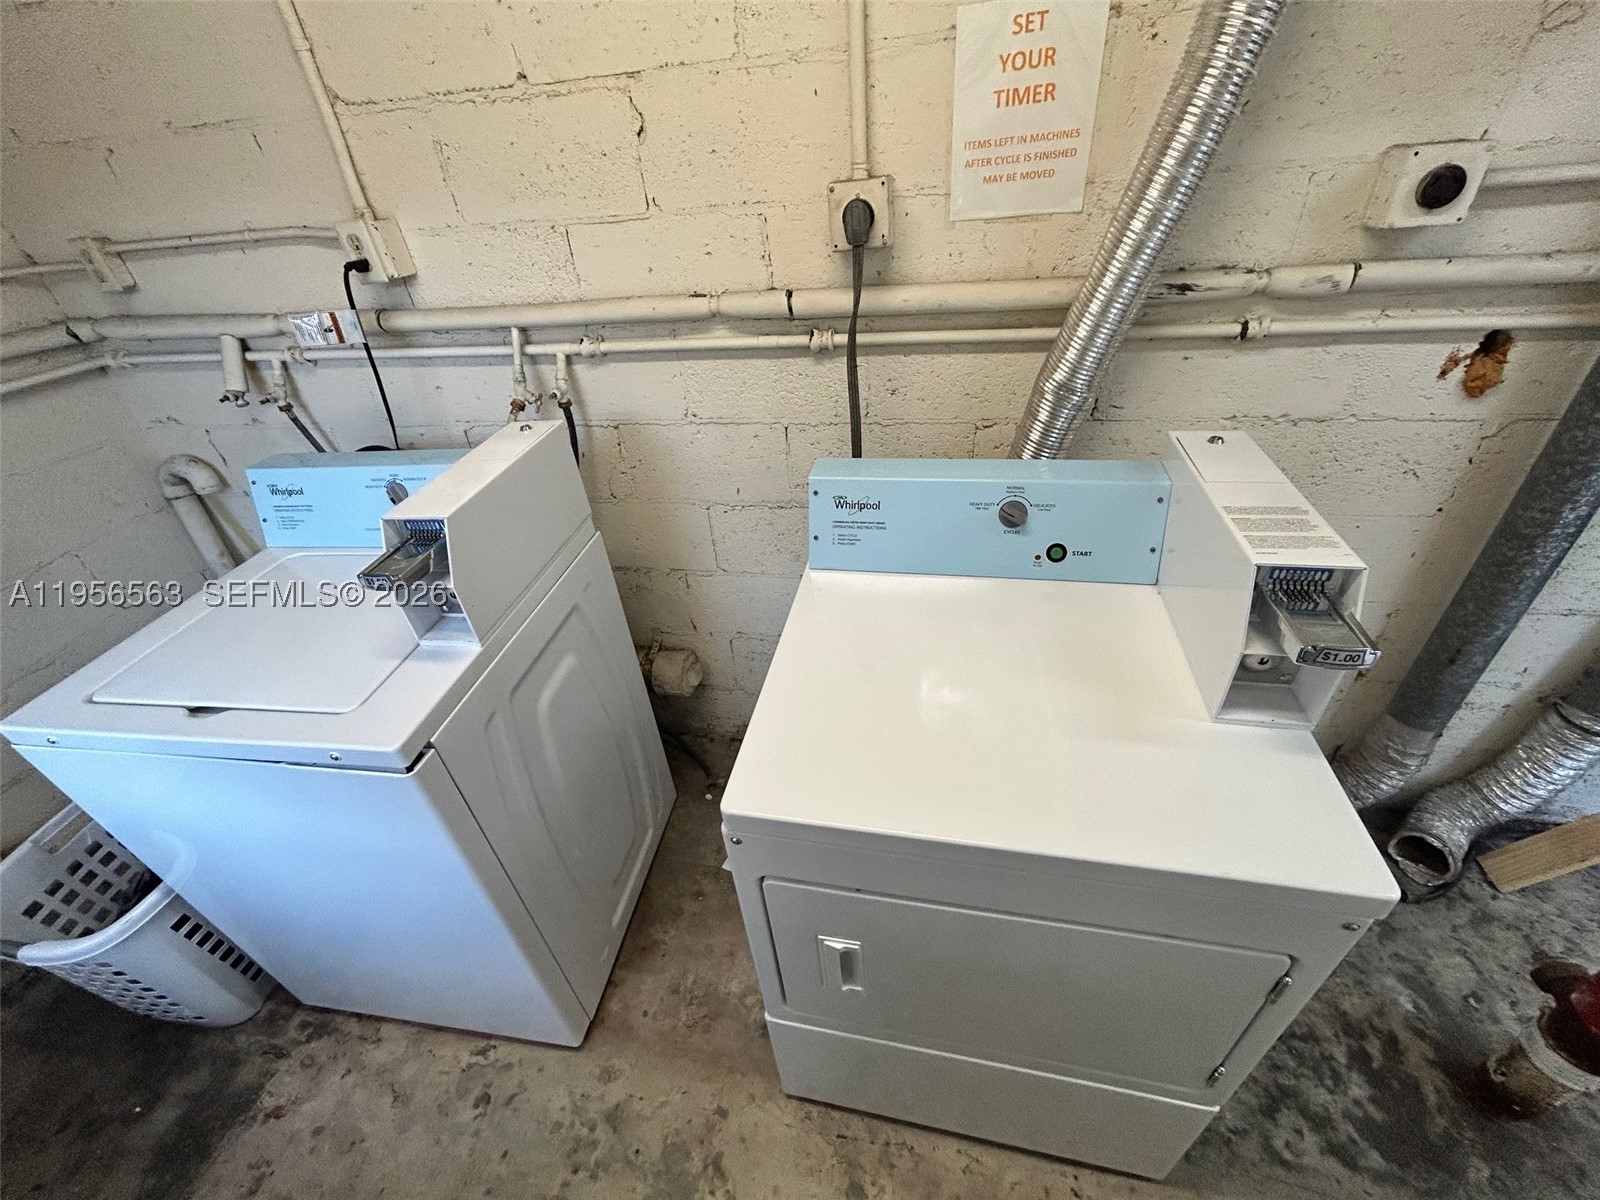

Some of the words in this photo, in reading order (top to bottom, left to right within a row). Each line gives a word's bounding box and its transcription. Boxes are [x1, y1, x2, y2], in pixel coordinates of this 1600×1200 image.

[1012, 9, 1050, 36] SET
[998, 46, 1057, 73] YOUR
[993, 82, 1057, 109] TIMER
[964, 139, 992, 150] ITEMS
[994, 136, 1015, 148] LEFT
[1017, 135, 1028, 145] IN
[1030, 128, 1081, 144] MACHINES
[964, 157, 992, 169] AFTER
[994, 154, 1021, 166] CYCLE
[1023, 152, 1032, 163] IS
[1034, 148, 1078, 161] FINISHED
[983, 174, 1004, 185] MAY
[1006, 172, 1018, 182] BE
[1020, 168, 1056, 180] MOVED
[269, 487, 304, 498] Whirlpool
[833, 500, 881, 513] Whirlpool
[1321, 651, 1362, 664] $1.00
